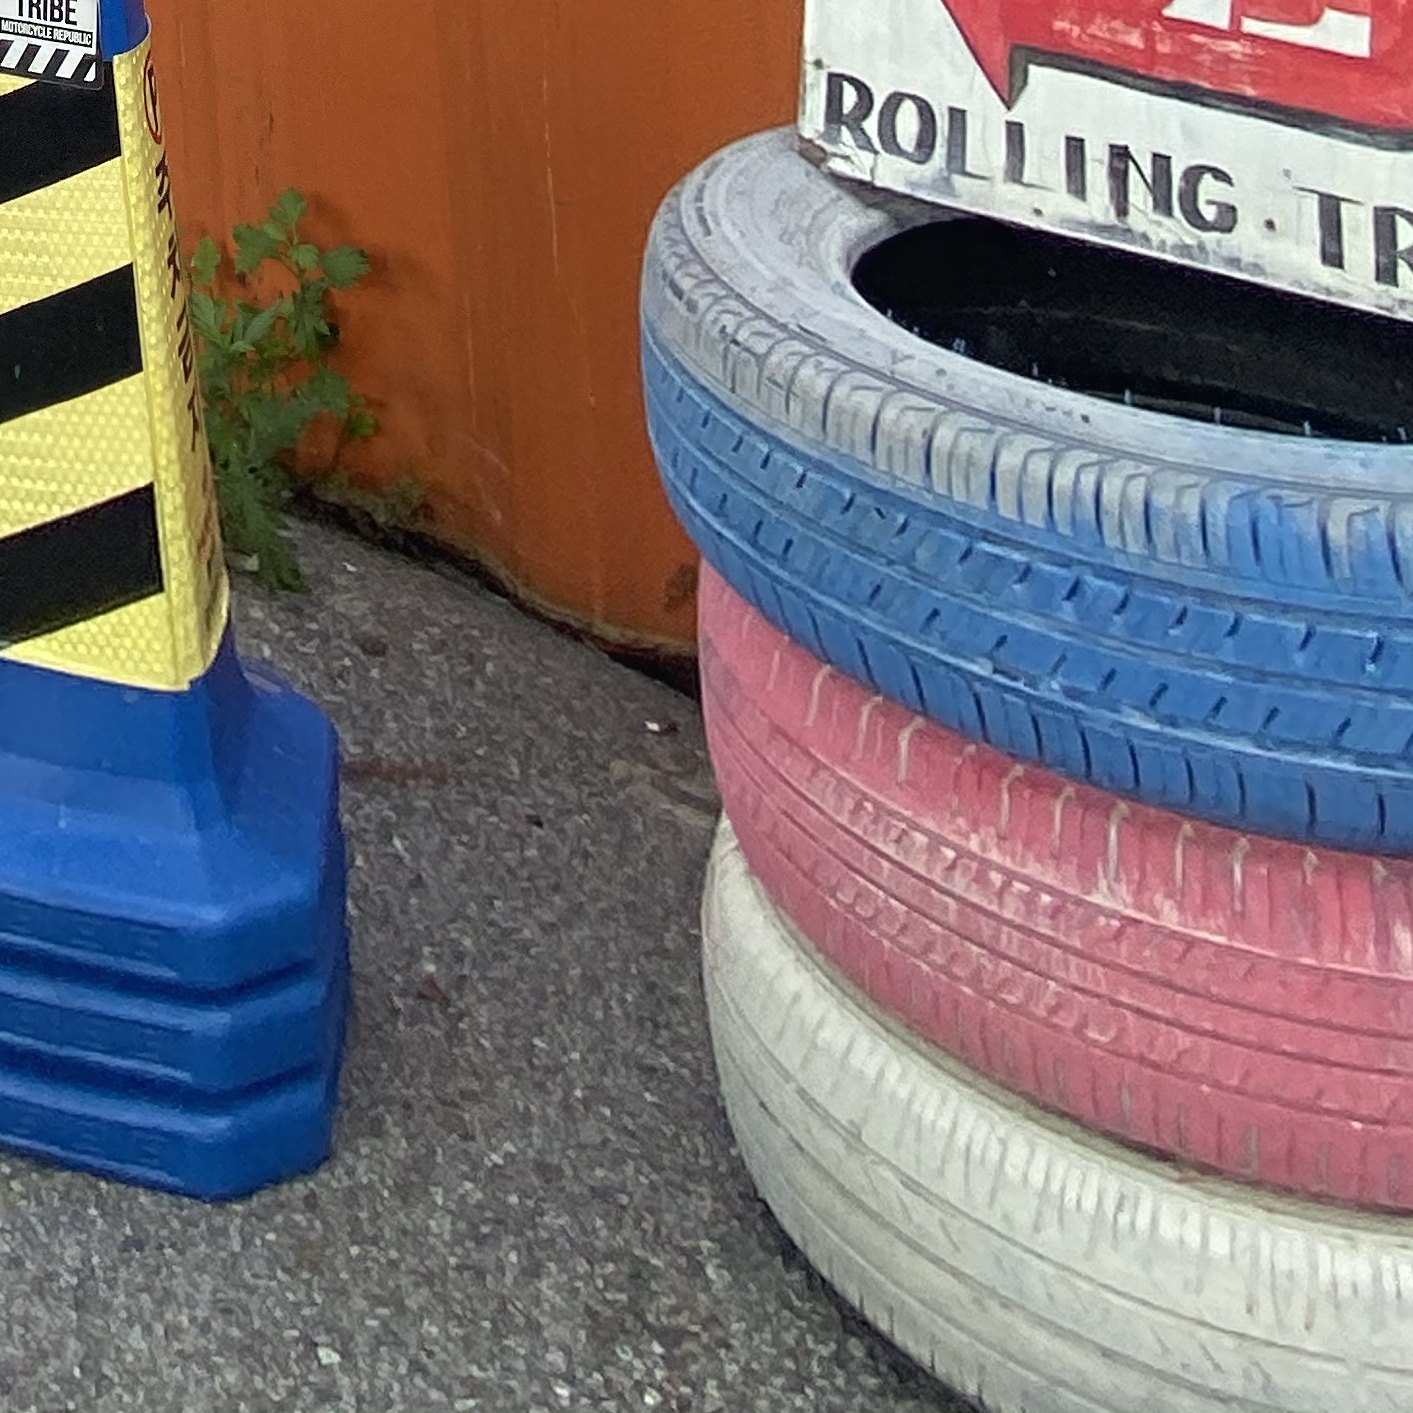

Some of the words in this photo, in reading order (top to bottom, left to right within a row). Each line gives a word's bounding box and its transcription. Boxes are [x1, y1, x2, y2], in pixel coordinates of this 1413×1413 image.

[1, 18, 53, 40] MOTORCYCLE
[53, 28, 93, 46] REPUBLIC
[824, 71, 1239, 235] ROLLING
